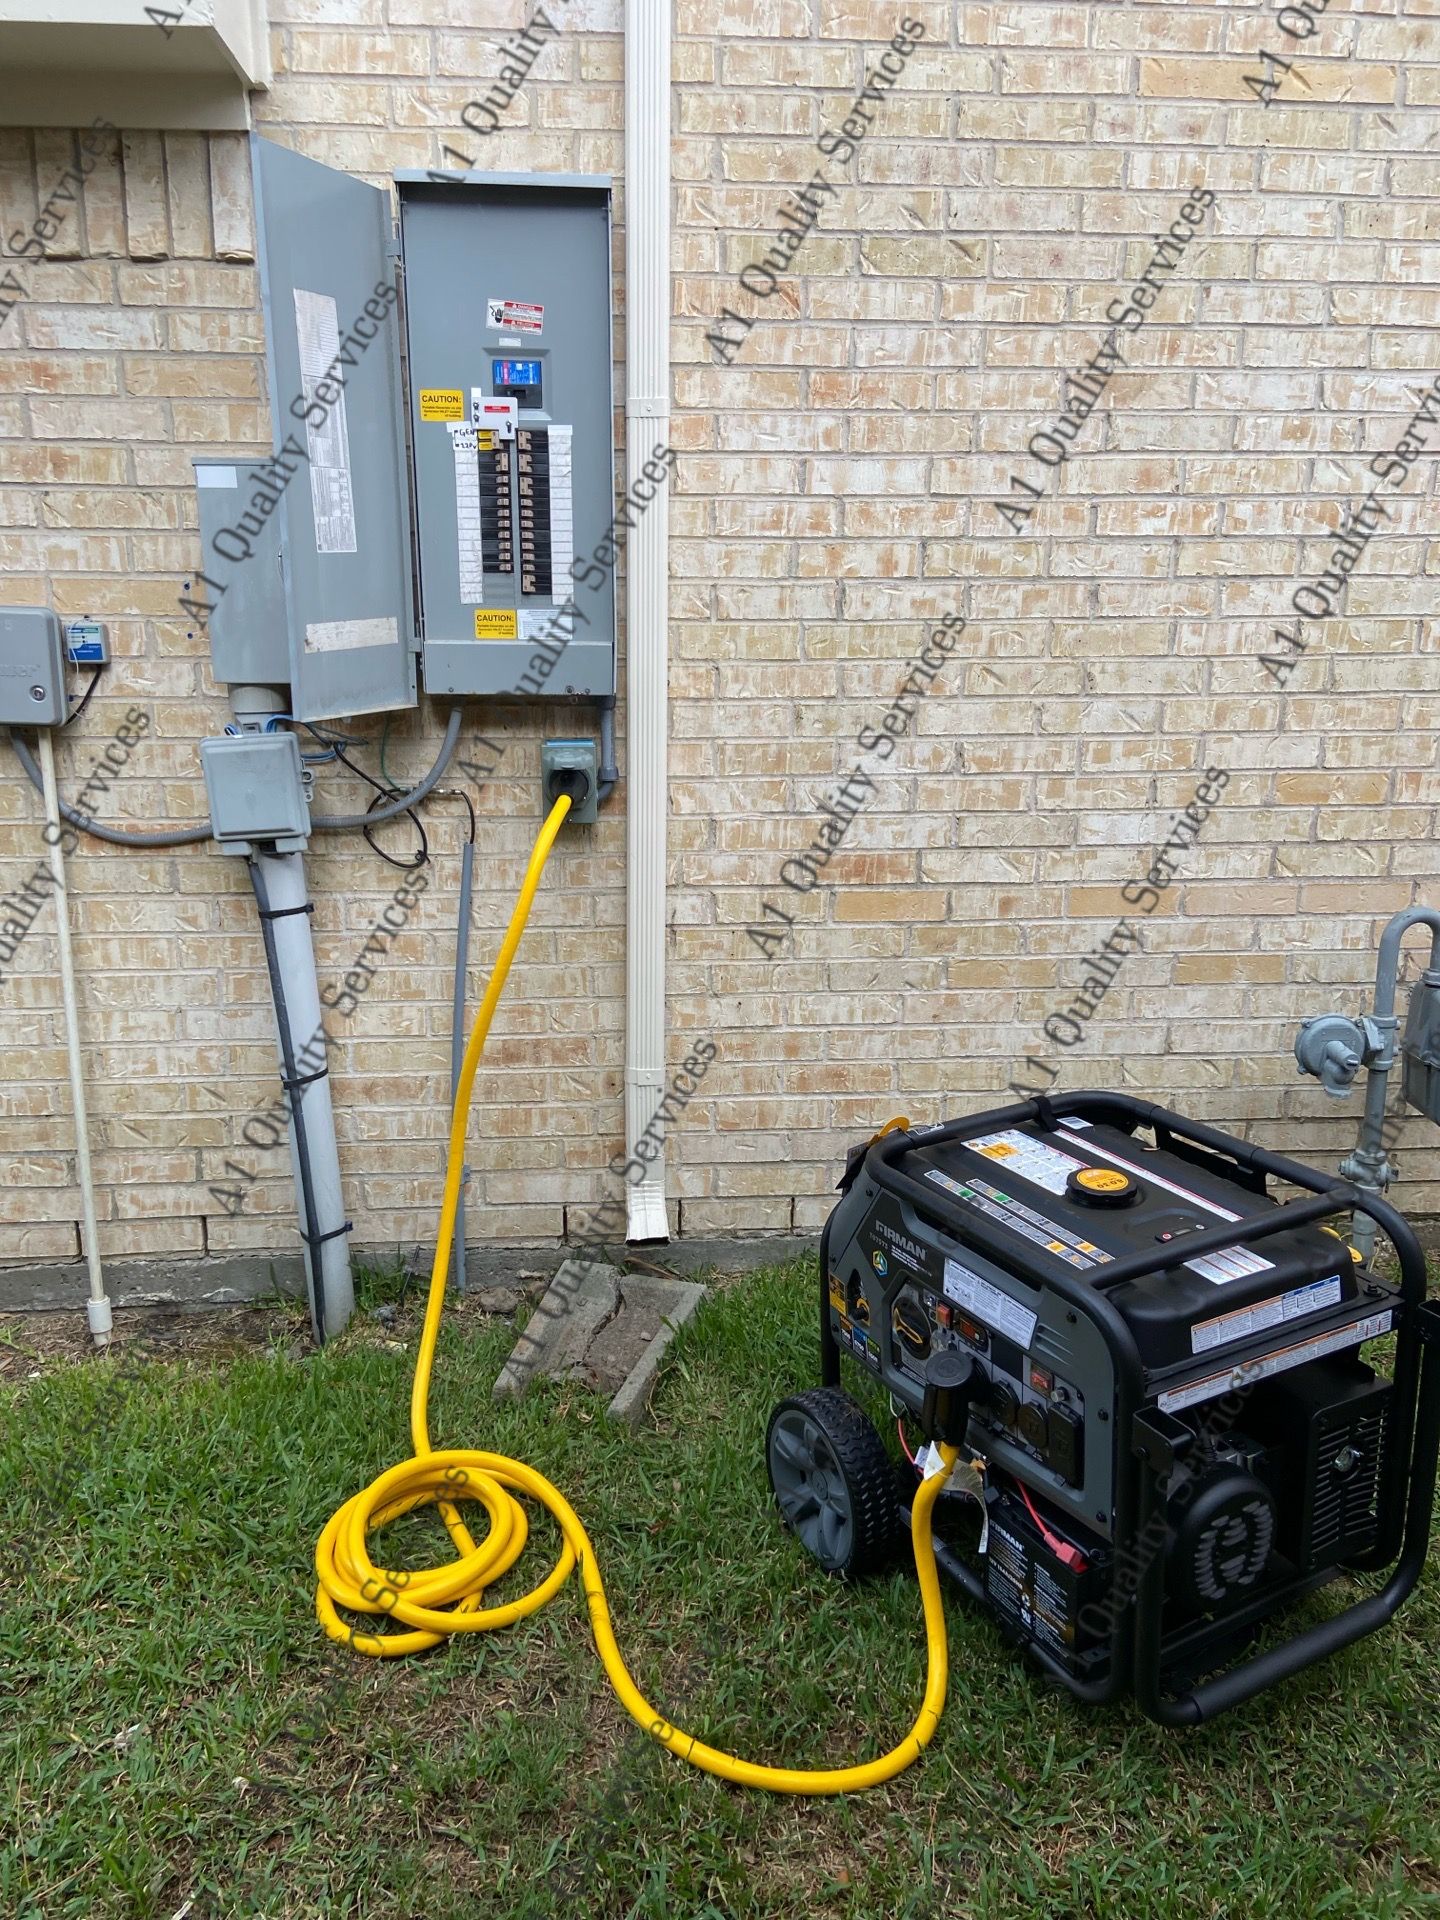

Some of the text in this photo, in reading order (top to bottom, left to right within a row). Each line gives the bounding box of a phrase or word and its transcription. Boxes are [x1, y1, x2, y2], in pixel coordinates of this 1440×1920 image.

[421, 395, 462, 403] CAUTION:
[476, 614, 514, 622] CAUTION:
[875, 1219, 927, 1261] FIRMAN
